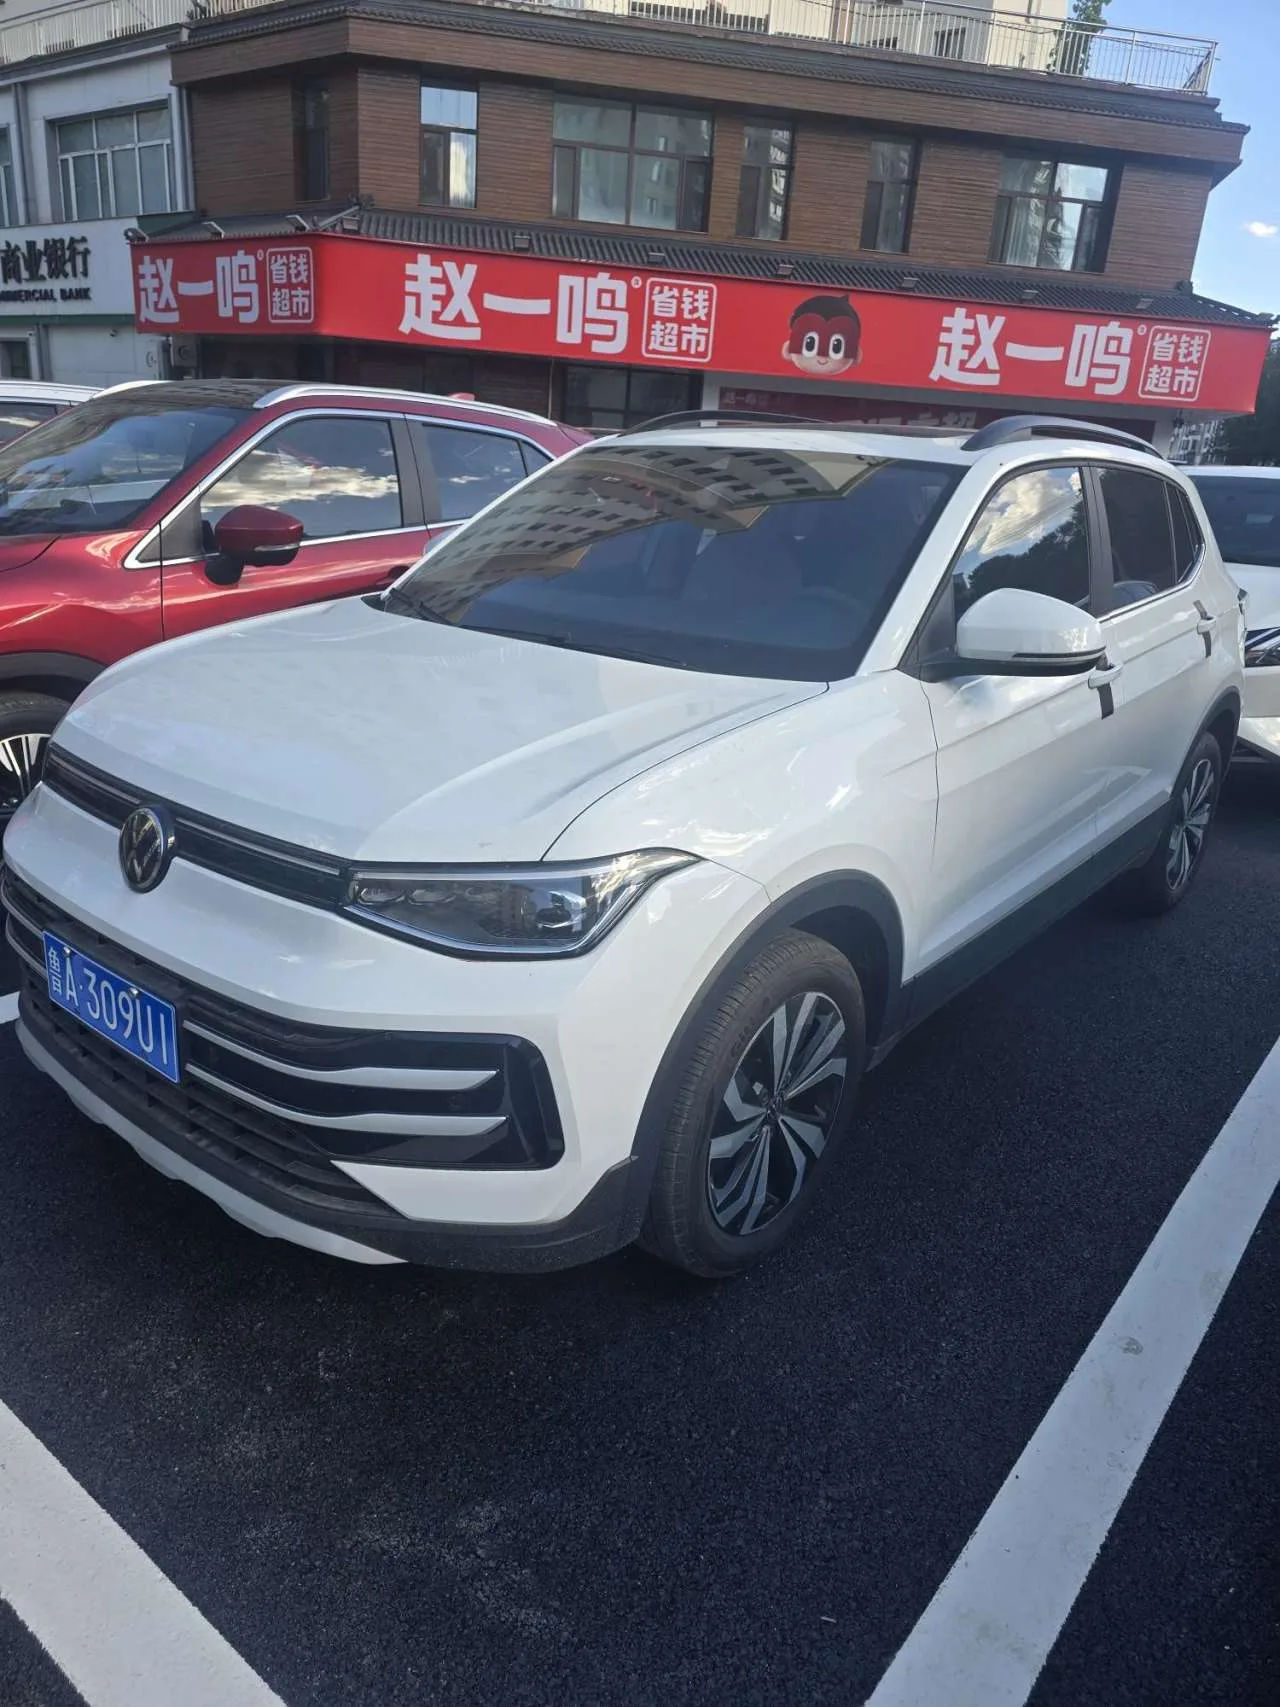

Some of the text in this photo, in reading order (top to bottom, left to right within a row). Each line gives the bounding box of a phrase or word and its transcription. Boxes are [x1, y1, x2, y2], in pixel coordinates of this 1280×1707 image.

[0, 236, 91, 285] 商业银行
[270, 253, 308, 283] 省钱
[60, 287, 92, 302] BANK
[138, 249, 259, 324] 赵一鸣
[272, 286, 310, 317] 超市
[398, 253, 629, 355] 赵一鸣
[651, 285, 709, 321] 省钱
[648, 320, 709, 355] 超市
[929, 307, 1133, 396] 赵一鸣
[1151, 331, 1205, 365] 省钱
[1144, 365, 1199, 396] 超市
